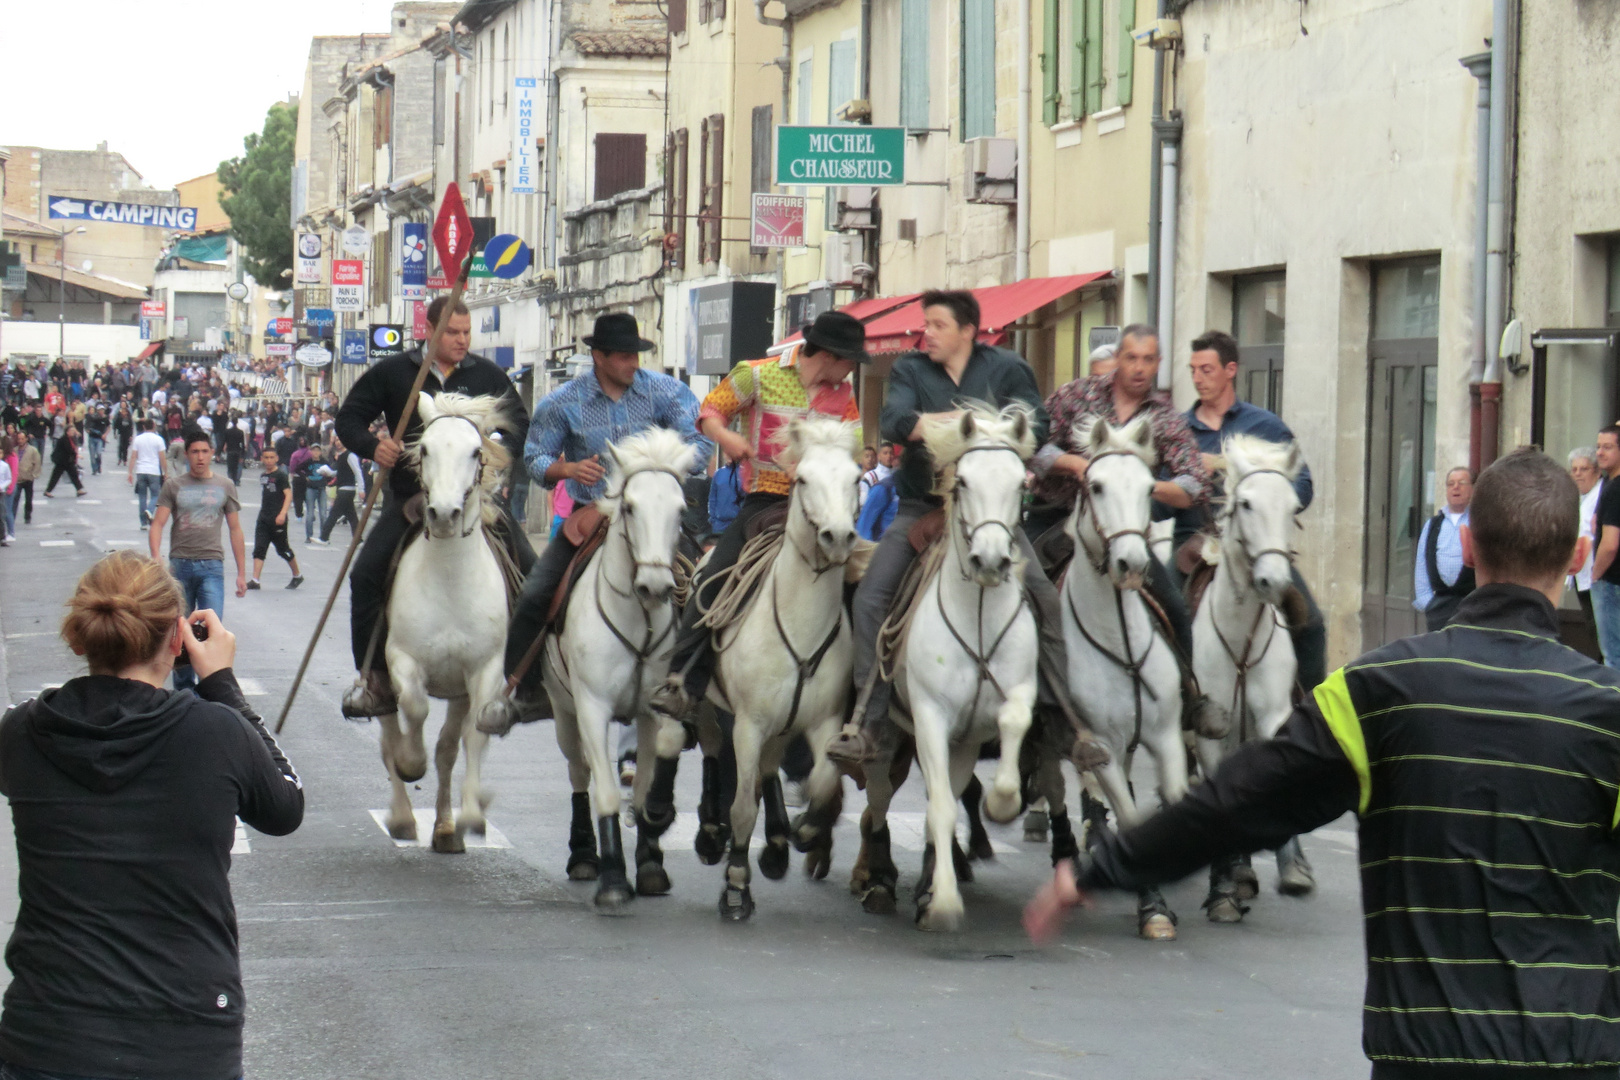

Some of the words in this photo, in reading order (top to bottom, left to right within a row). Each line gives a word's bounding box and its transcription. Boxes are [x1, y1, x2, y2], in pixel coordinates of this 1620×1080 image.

[518, 89, 532, 185] IMMOBILIER
[809, 133, 875, 153] MICHEL
[790, 158, 893, 179] CHAUSSEUR
[756, 196, 803, 208] COIFFURE
[88, 201, 195, 229] CAMPING
[756, 207, 794, 218] MIXTE
[448, 215, 457, 255] TABAC
[755, 235, 802, 246] PLATINE
[338, 264, 357, 273] Farine
[338, 287, 350, 296] PAIN
[351, 287, 357, 296] LE
[336, 296, 360, 305] TORCHON
[277, 320, 292, 330] SFR
